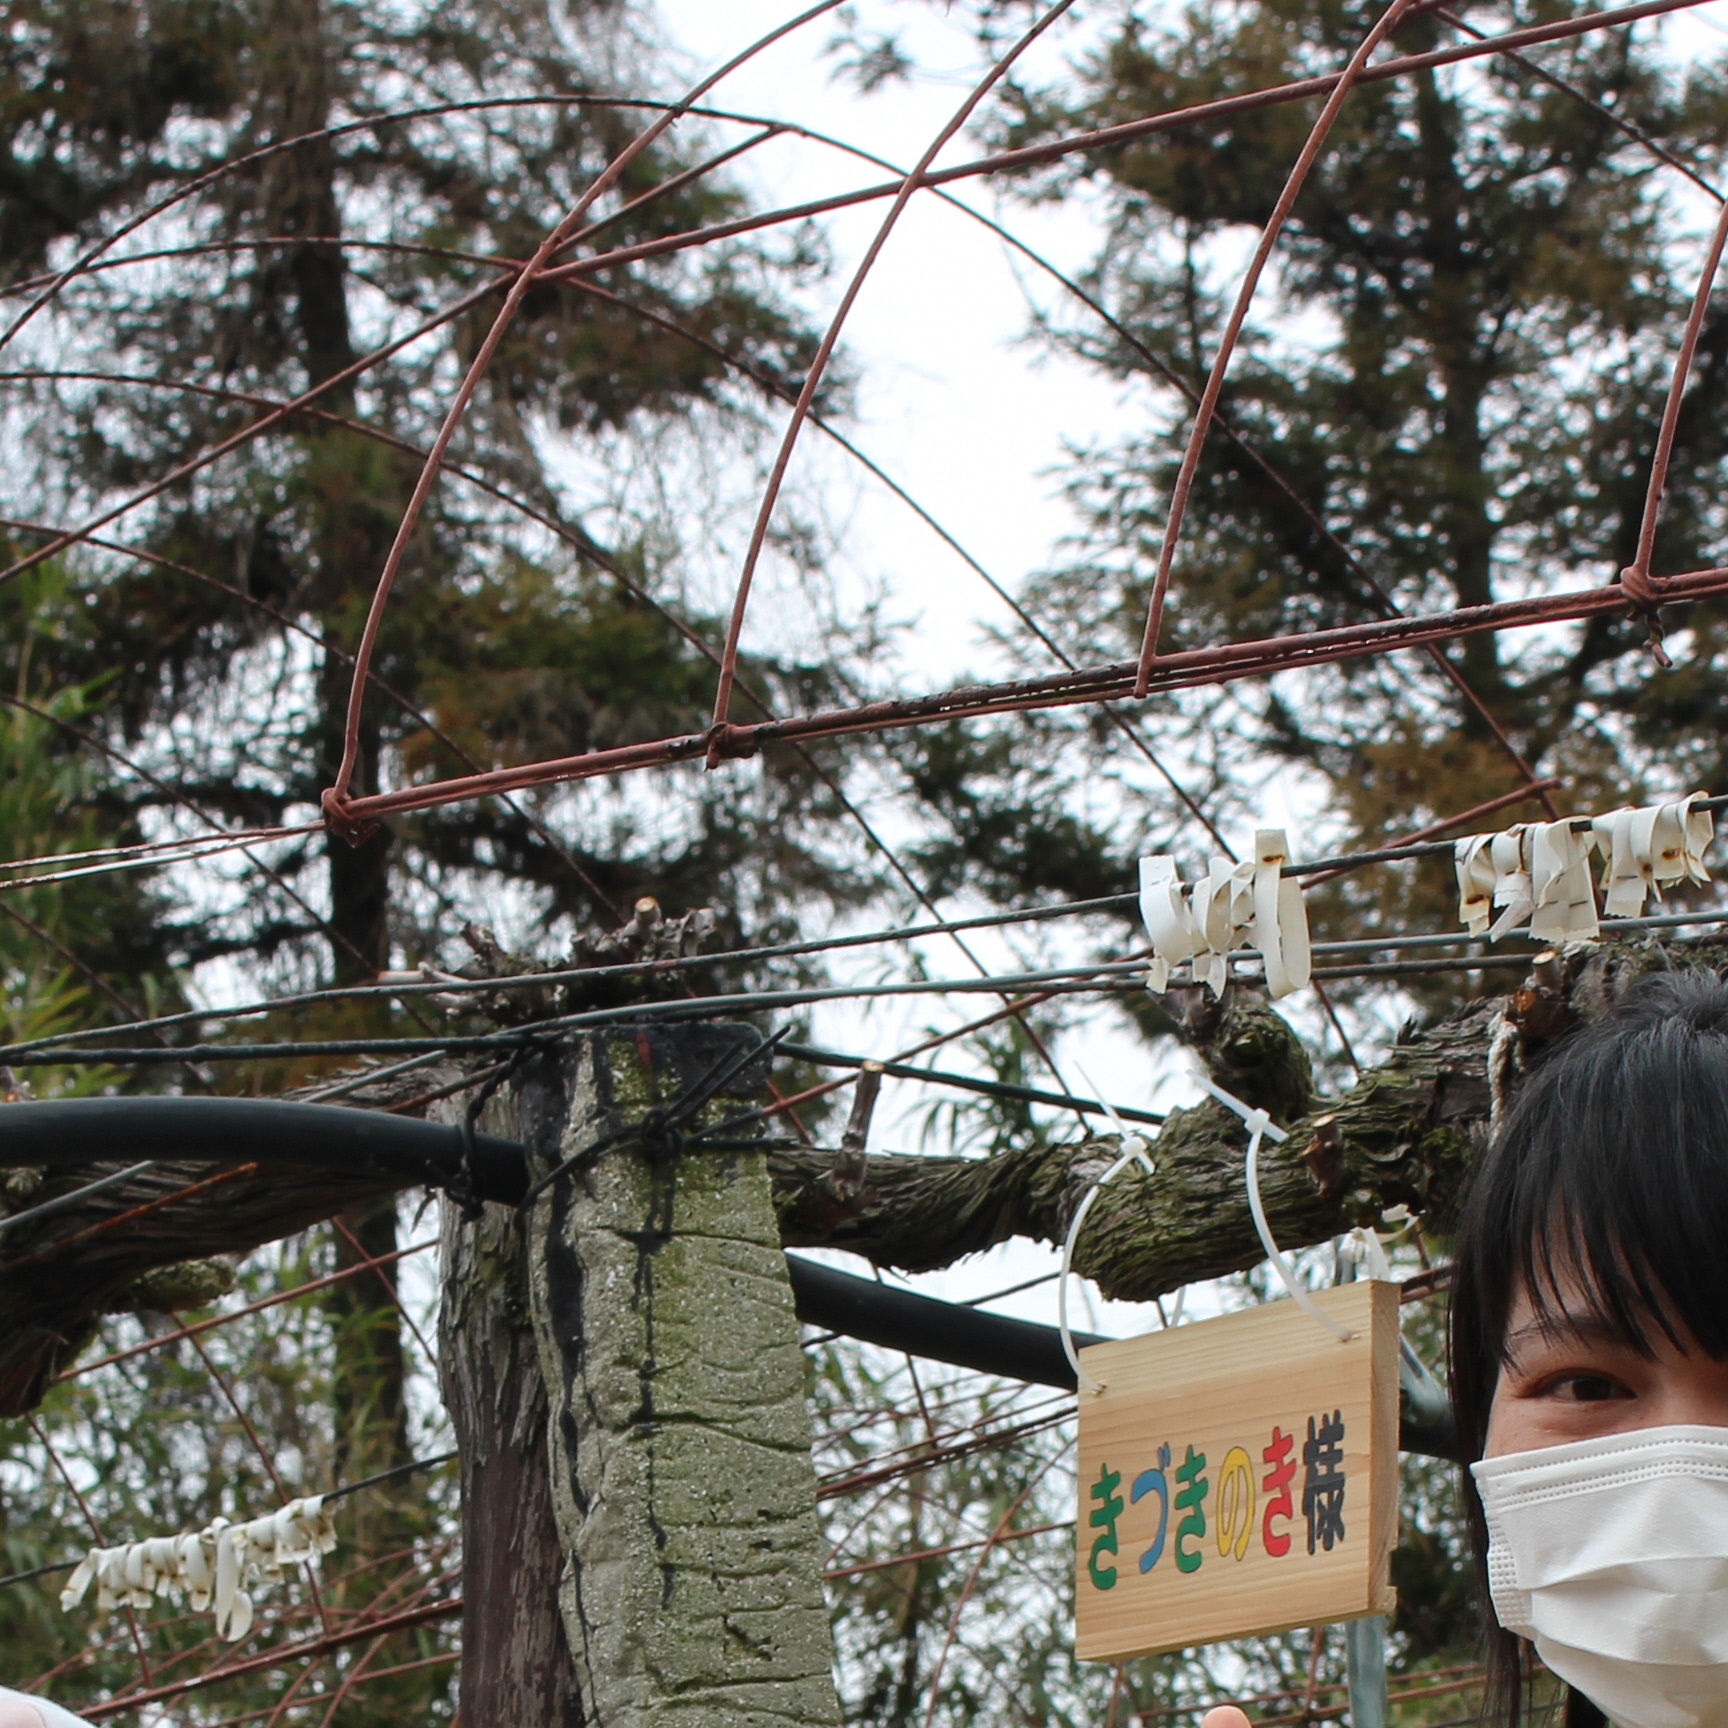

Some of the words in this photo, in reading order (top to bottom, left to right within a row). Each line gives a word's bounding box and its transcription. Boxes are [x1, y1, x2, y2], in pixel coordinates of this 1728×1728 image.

[1087, 1408, 1345, 1590] きづきのき様
